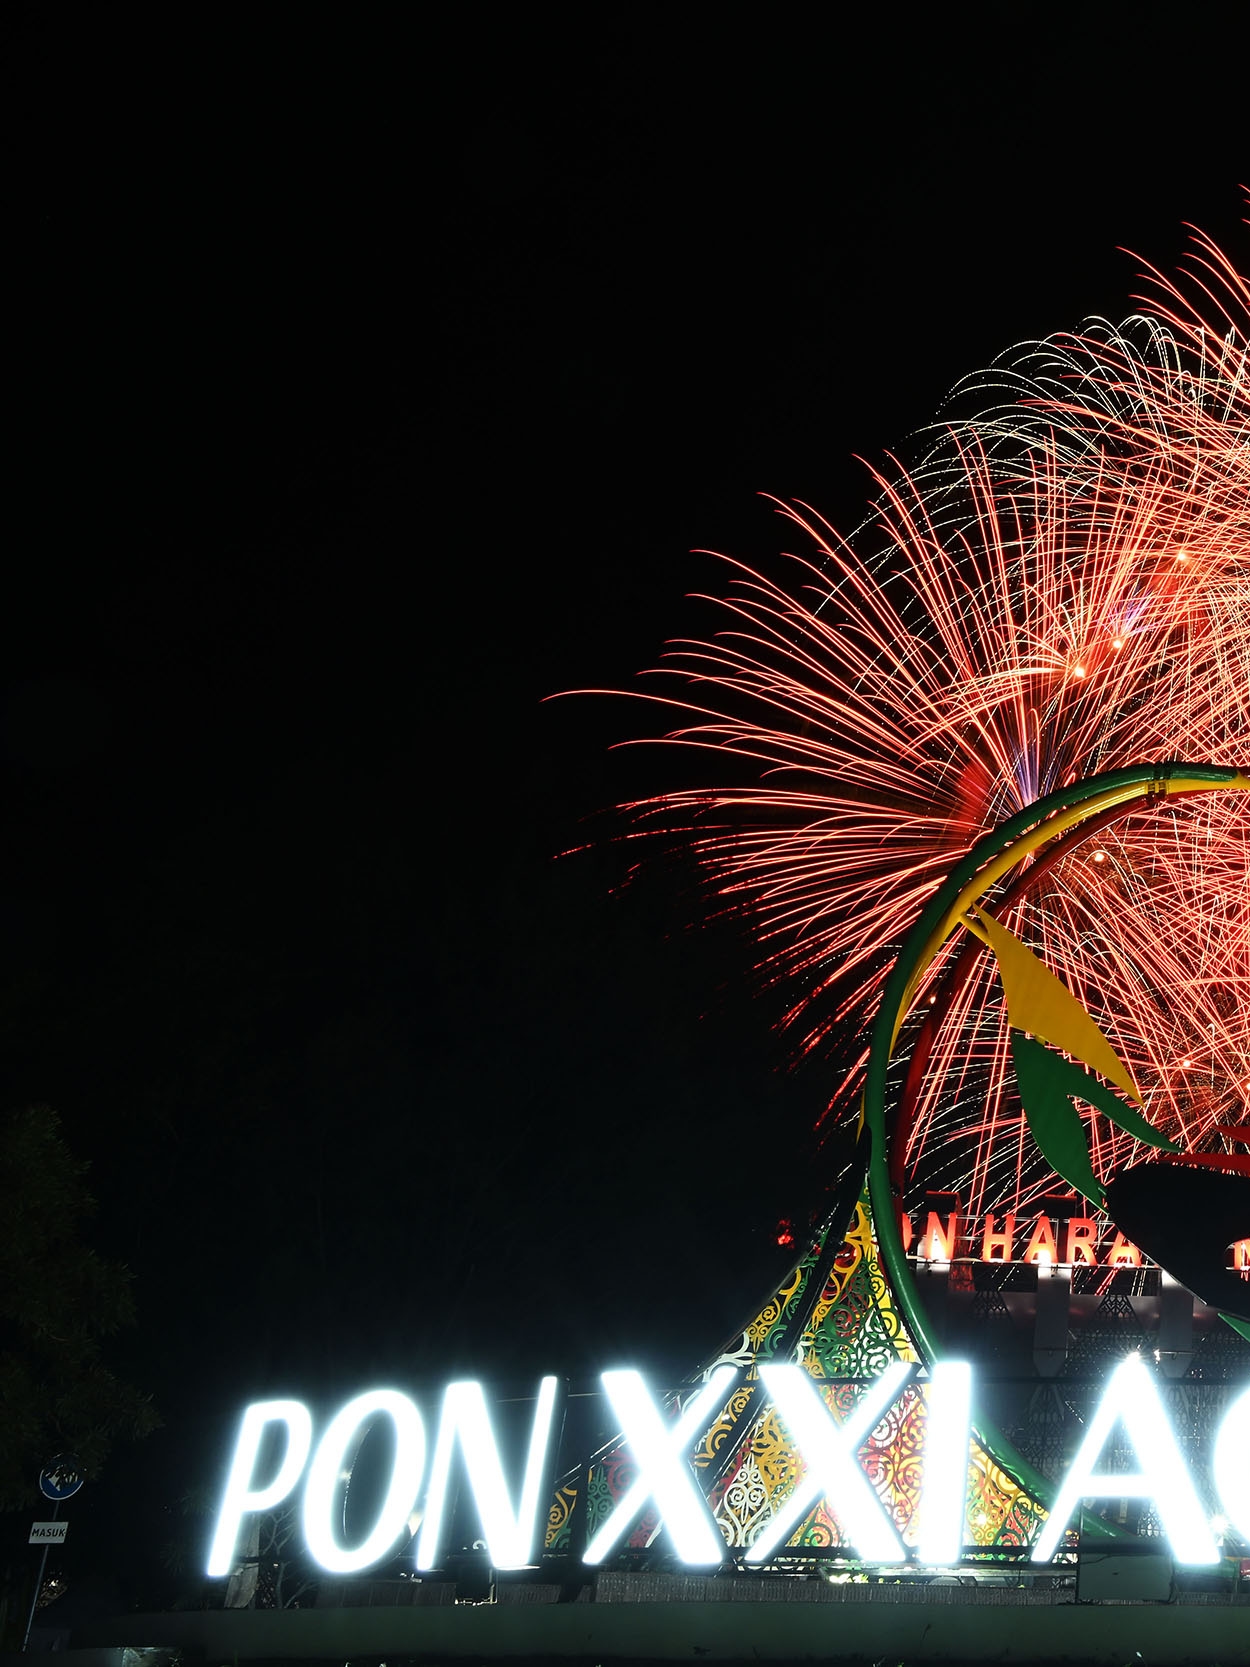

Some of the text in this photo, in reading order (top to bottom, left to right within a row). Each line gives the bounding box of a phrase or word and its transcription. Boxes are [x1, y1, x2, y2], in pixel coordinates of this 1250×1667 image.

[207, 1375, 558, 1577] PON
[582, 1360, 972, 1564] XXI
[31, 1528, 66, 1537] MASUK
